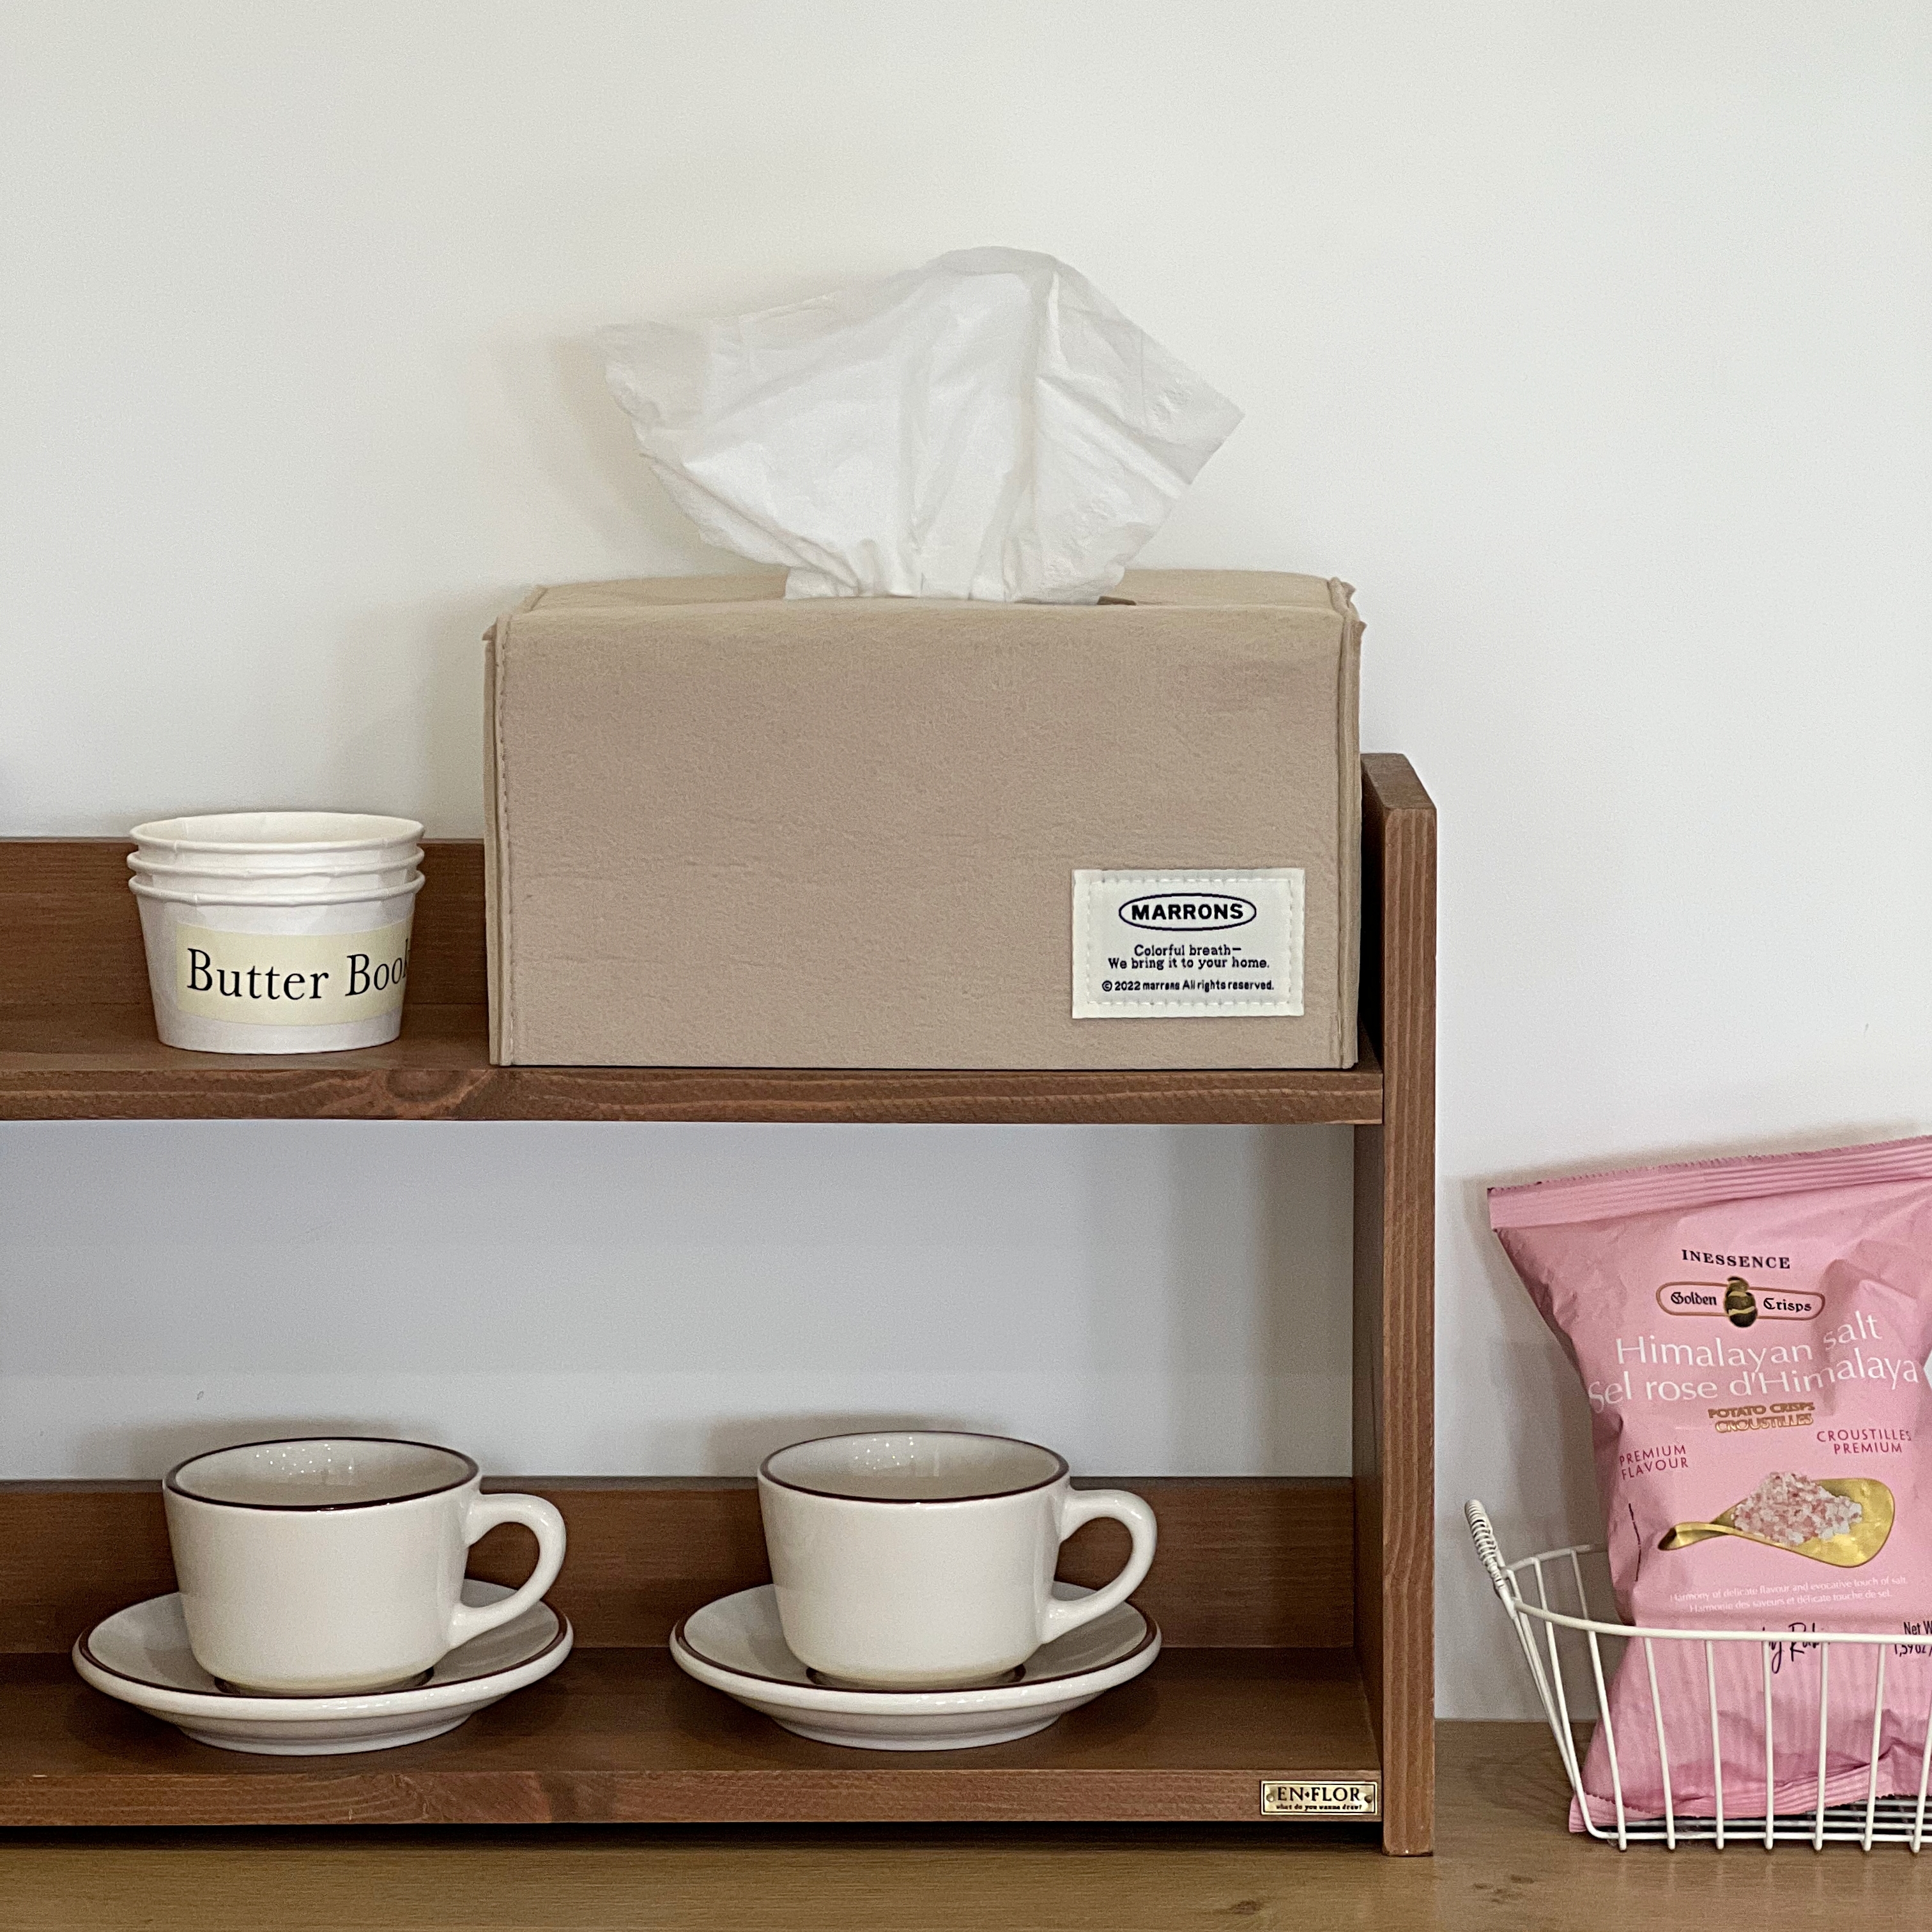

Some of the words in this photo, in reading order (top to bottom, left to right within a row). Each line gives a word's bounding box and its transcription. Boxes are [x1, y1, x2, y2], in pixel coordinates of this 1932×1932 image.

[1131, 904, 1243, 920] MARRONS
[1134, 944, 1184, 956] Colorful
[1108, 958, 1127, 969] We
[1131, 957, 1164, 970] bring
[1169, 956, 1177, 969] it
[1181, 958, 1194, 969] to
[1198, 959, 1227, 970] your
[1232, 956, 1269, 969] home.
[187, 947, 329, 1000] Butter
[1114, 981, 1141, 991] 2022
[1142, 982, 1180, 990] marrons
[1182, 979, 1195, 990] All
[1197, 979, 1226, 993] rights
[1228, 979, 1275, 990] reserved.
[1682, 1249, 1790, 1269] INESSENCE
[1671, 1291, 1717, 1306] Golden
[1763, 1298, 1812, 1313] Crisps
[1616, 1334, 1813, 1373] Himalayan
[1823, 1310, 1883, 1351] salt
[1646, 1381, 1718, 1401] rose
[1729, 1347, 1919, 1398] d'Himalaya
[1708, 1405, 1767, 1418] POTATO
[1769, 1402, 1816, 1414] CRISPS
[1715, 1413, 1814, 1433] CROUSTILLES
[1816, 1429, 1912, 1442] CROUSTILLES
[1619, 1445, 1686, 1467] PREMIUM
[1834, 1442, 1903, 1455] PREMIUM
[1621, 1457, 1689, 1480] FLAVOUR
[1903, 1621, 1920, 1635] Net
